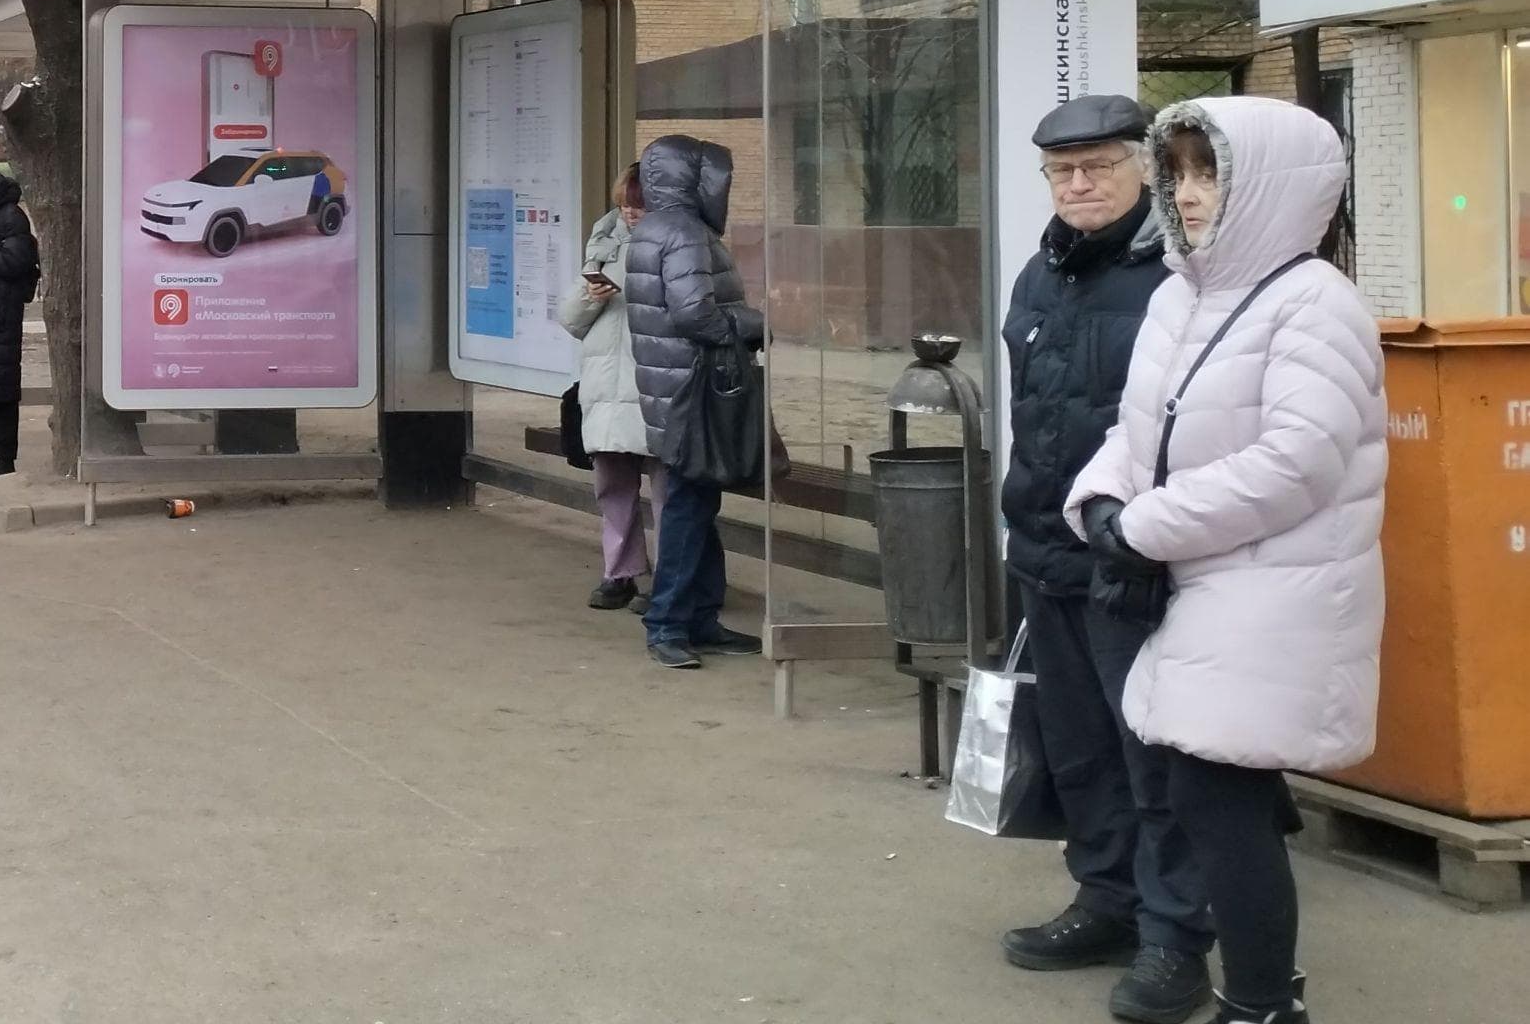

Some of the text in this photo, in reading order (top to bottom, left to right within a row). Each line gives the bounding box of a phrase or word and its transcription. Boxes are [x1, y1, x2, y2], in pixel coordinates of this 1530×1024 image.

[160, 274, 218, 284] Бронировать
[195, 296, 266, 307] Приложение
[195, 310, 336, 322] «Московский транспорт»
